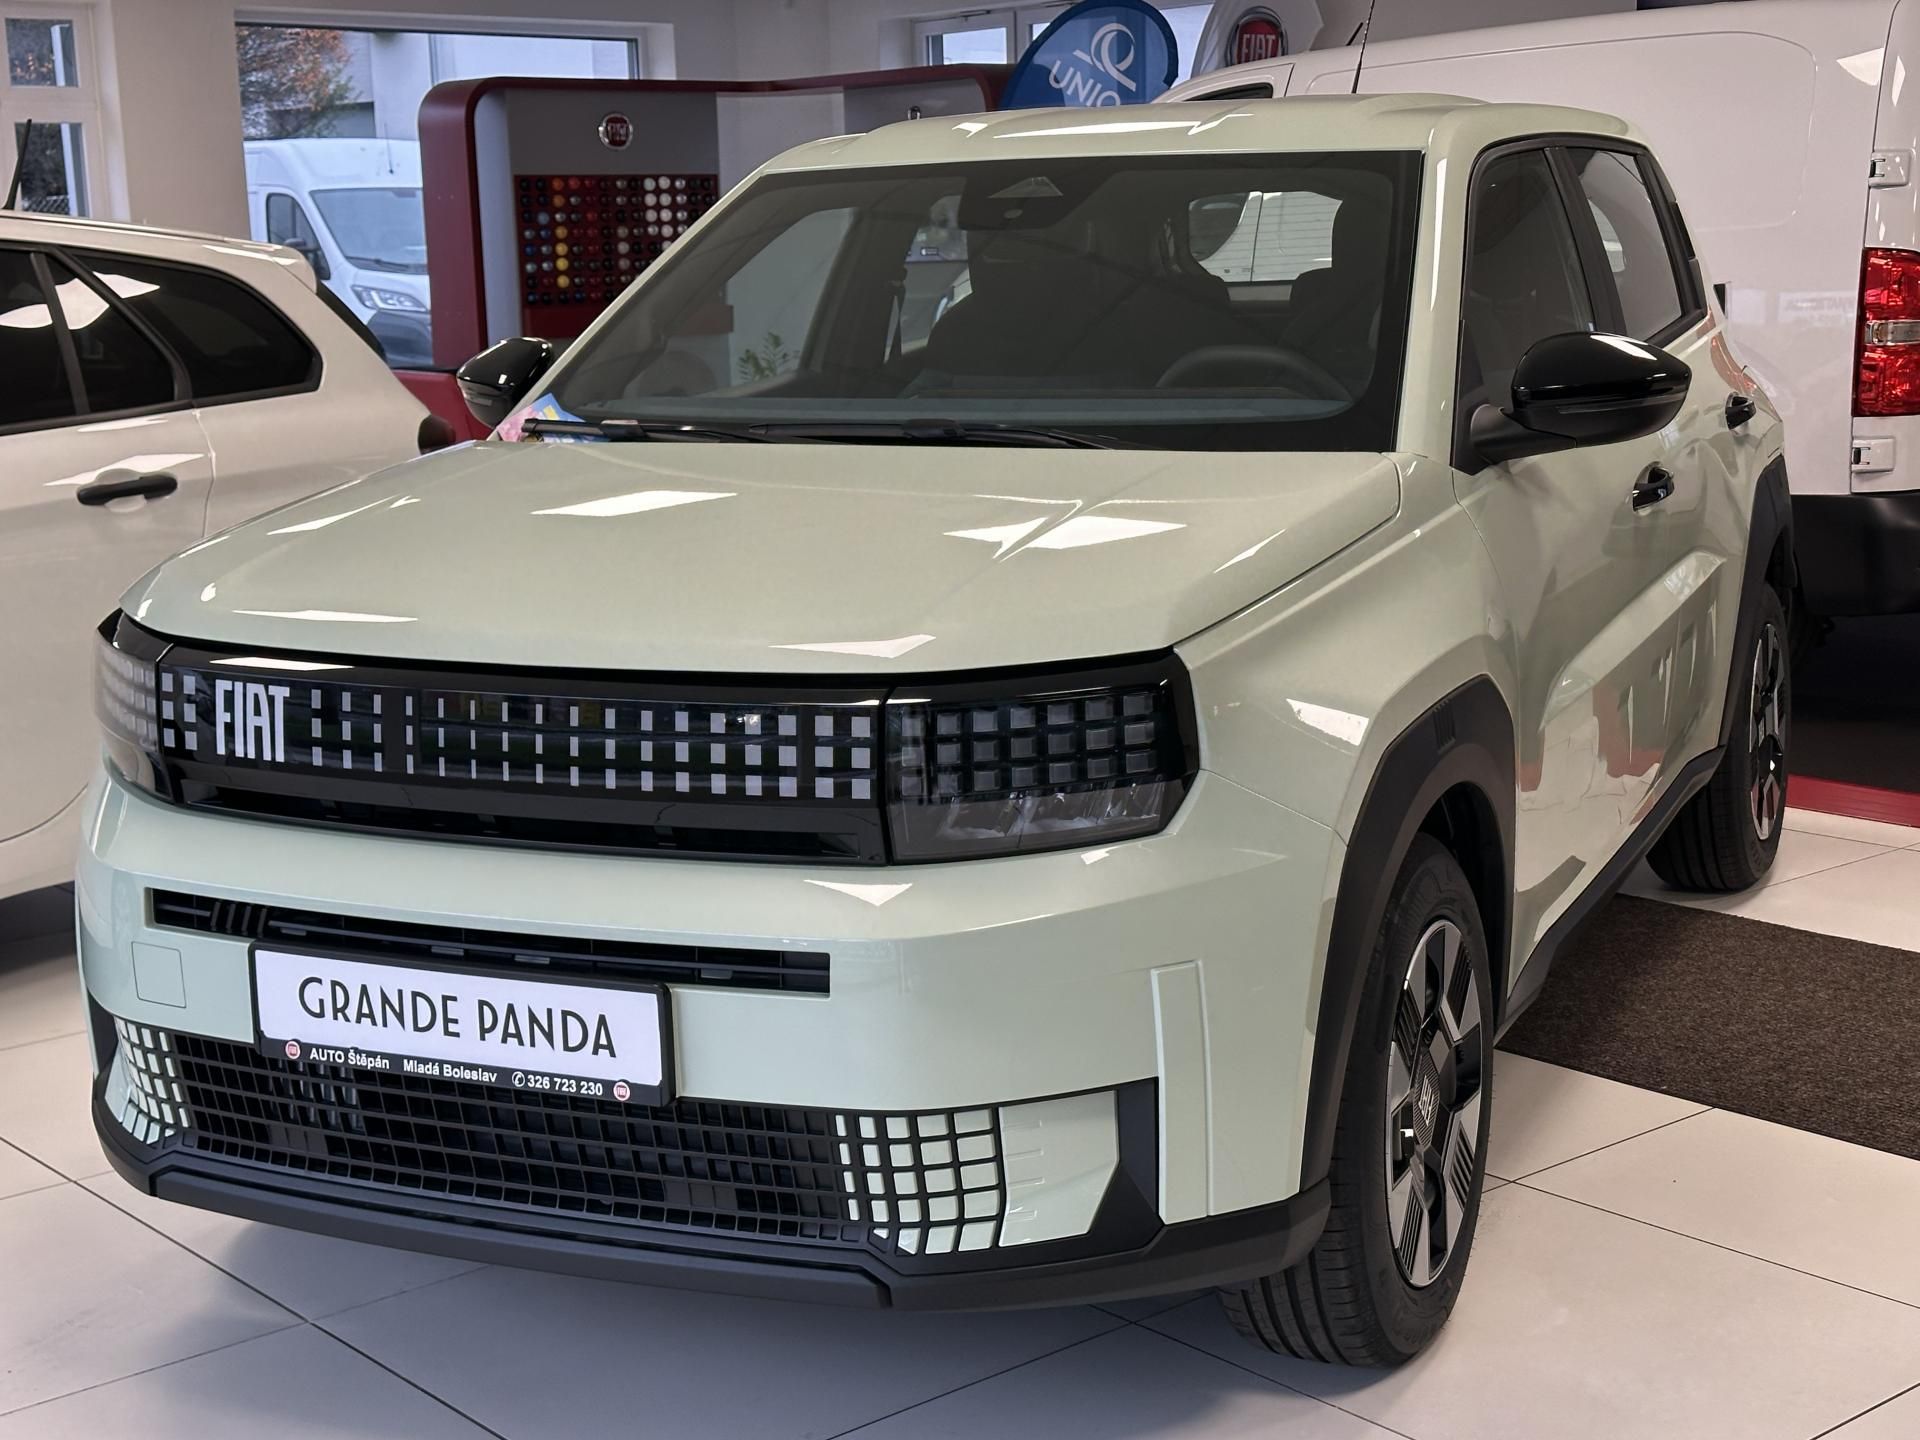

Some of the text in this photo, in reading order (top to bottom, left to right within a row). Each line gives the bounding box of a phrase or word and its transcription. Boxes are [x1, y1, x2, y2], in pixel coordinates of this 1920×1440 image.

[1241, 33, 1276, 62] FIAT
[215, 679, 290, 763] FIAT
[299, 976, 617, 1059] GRANDE PANDA
[310, 1047, 345, 1063] AUTO
[348, 1049, 390, 1070] Štěpán
[403, 1058, 440, 1076] Mladá
[443, 1063, 498, 1083] Boleslav
[527, 1074, 550, 1090] 326
[553, 1077, 577, 1093] 723
[580, 1080, 603, 1096] 230
